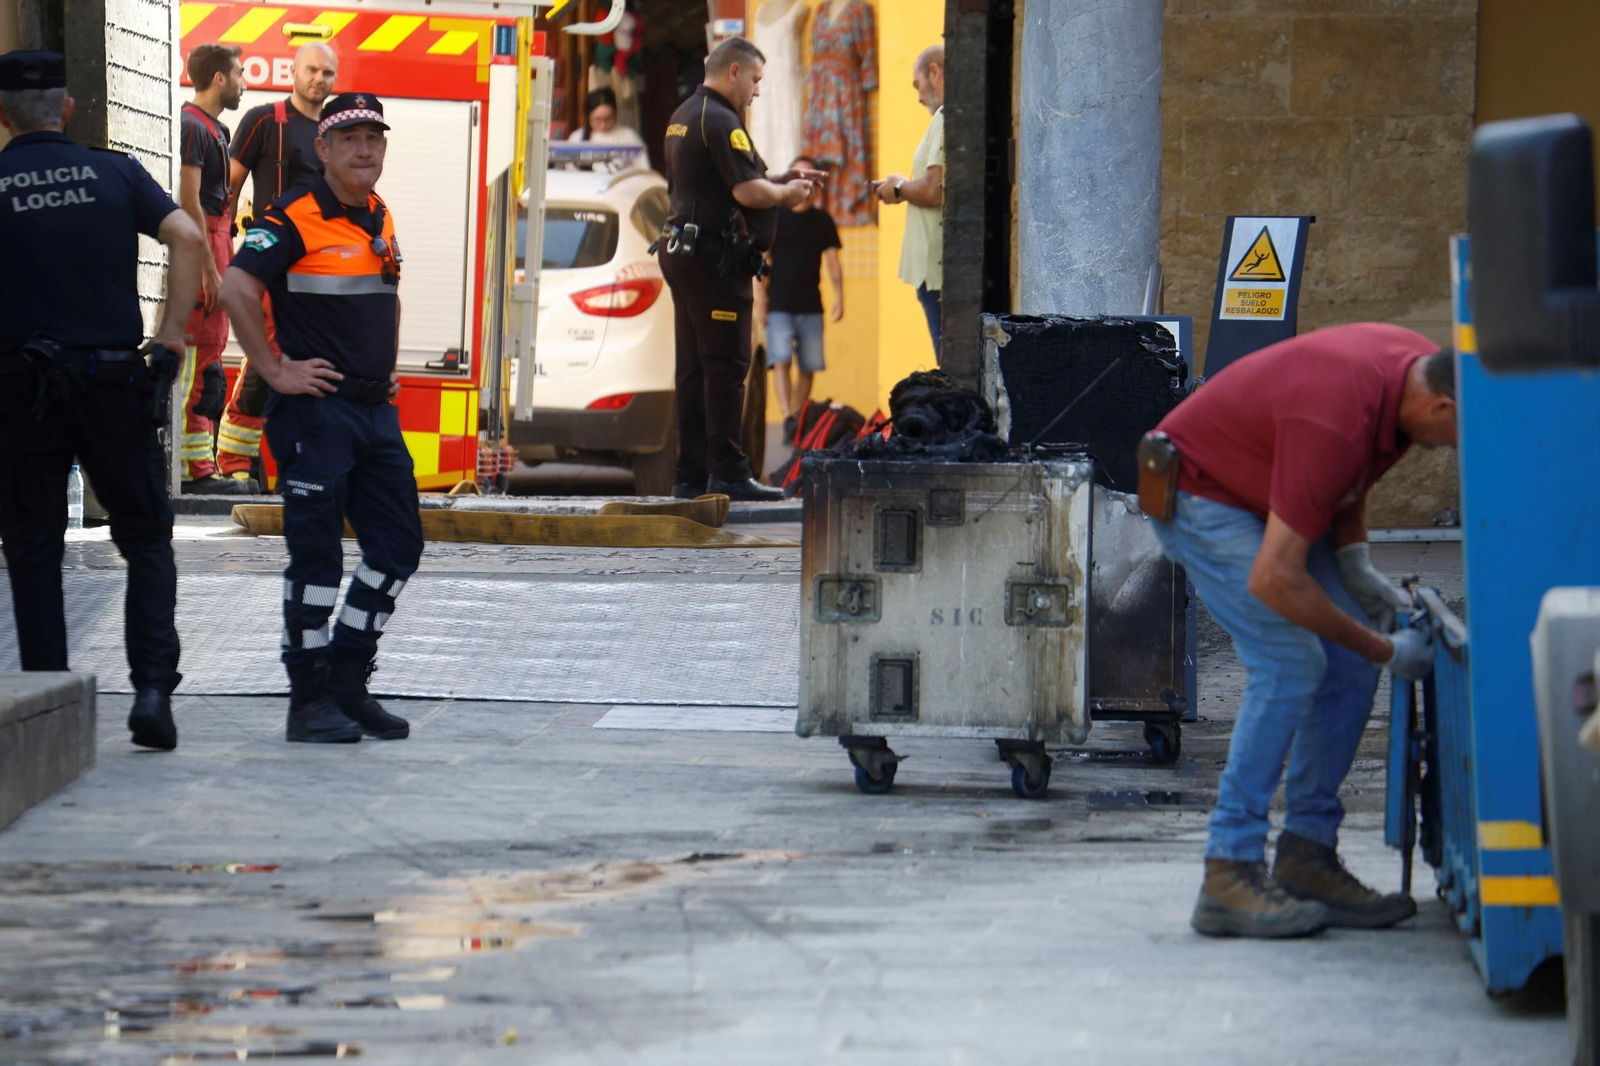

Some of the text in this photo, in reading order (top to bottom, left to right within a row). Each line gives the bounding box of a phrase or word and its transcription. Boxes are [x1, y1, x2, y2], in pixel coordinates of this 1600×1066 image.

[0, 166, 98, 192] POLICIA
[11, 187, 96, 212] LOCAL
[292, 488, 308, 496] CIVIL
